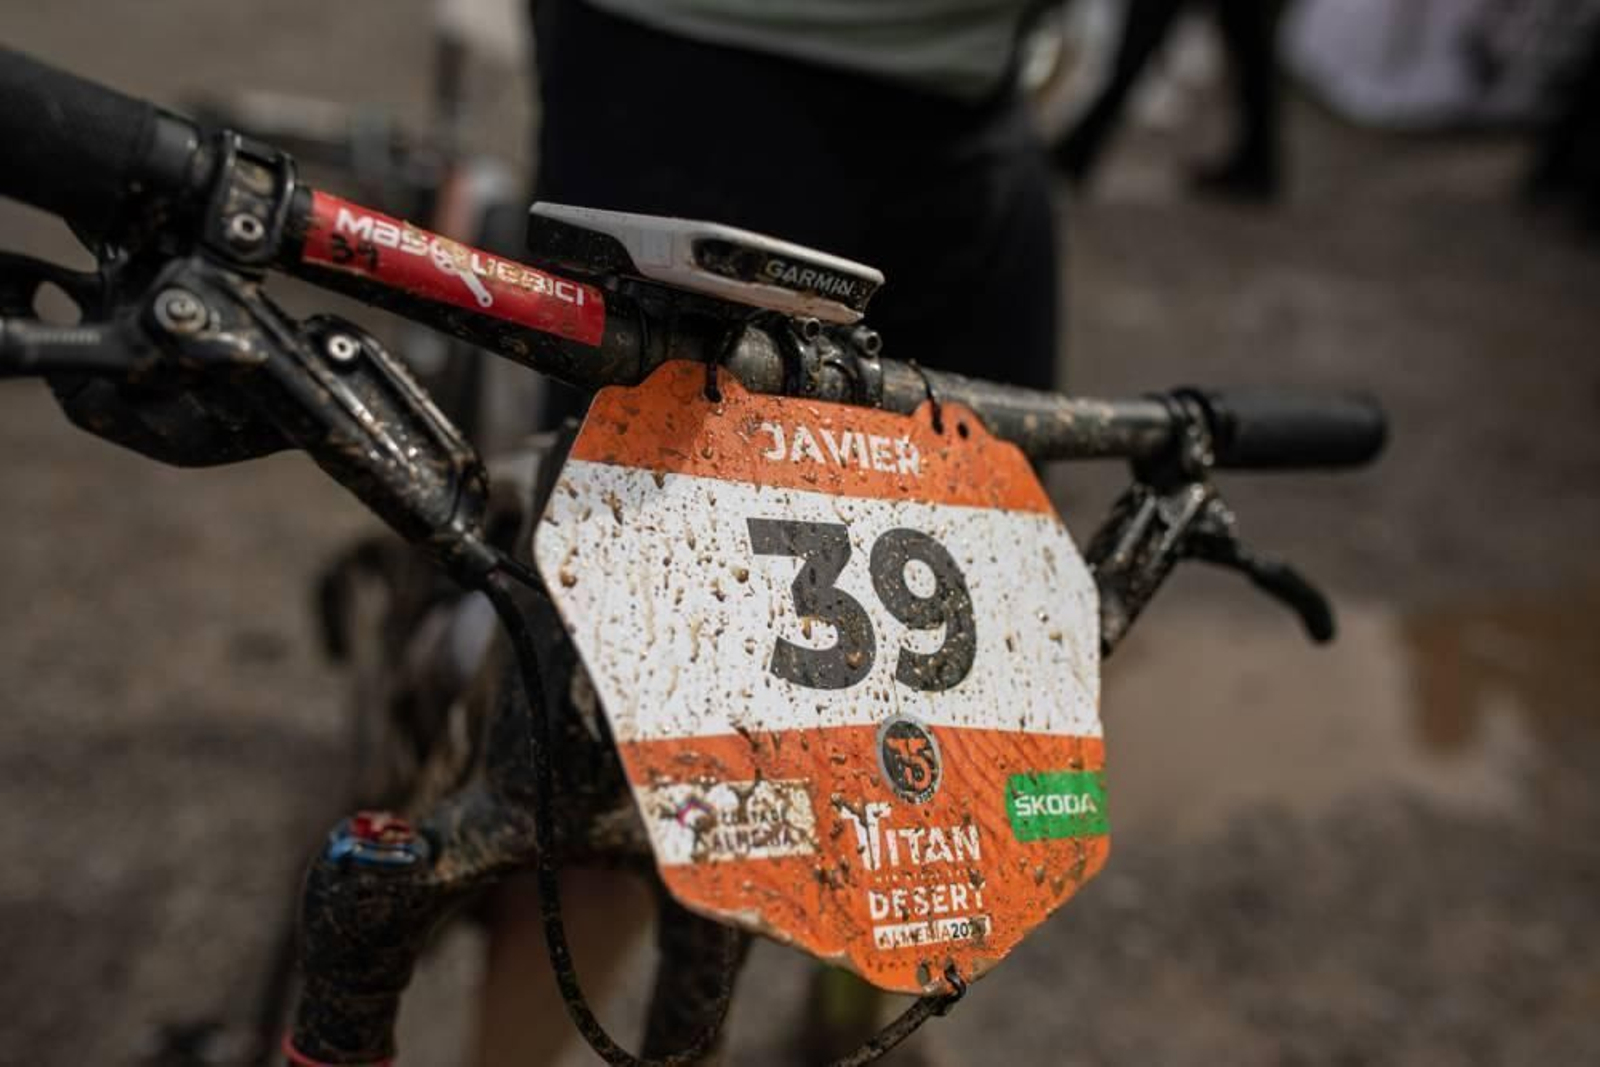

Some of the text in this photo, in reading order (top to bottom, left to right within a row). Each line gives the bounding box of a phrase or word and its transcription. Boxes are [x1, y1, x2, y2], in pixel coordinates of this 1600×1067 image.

[765, 261, 854, 296] GARMIN
[761, 422, 921, 476] JAVIER
[746, 517, 977, 692] 39
[840, 802, 981, 871] TITAN
